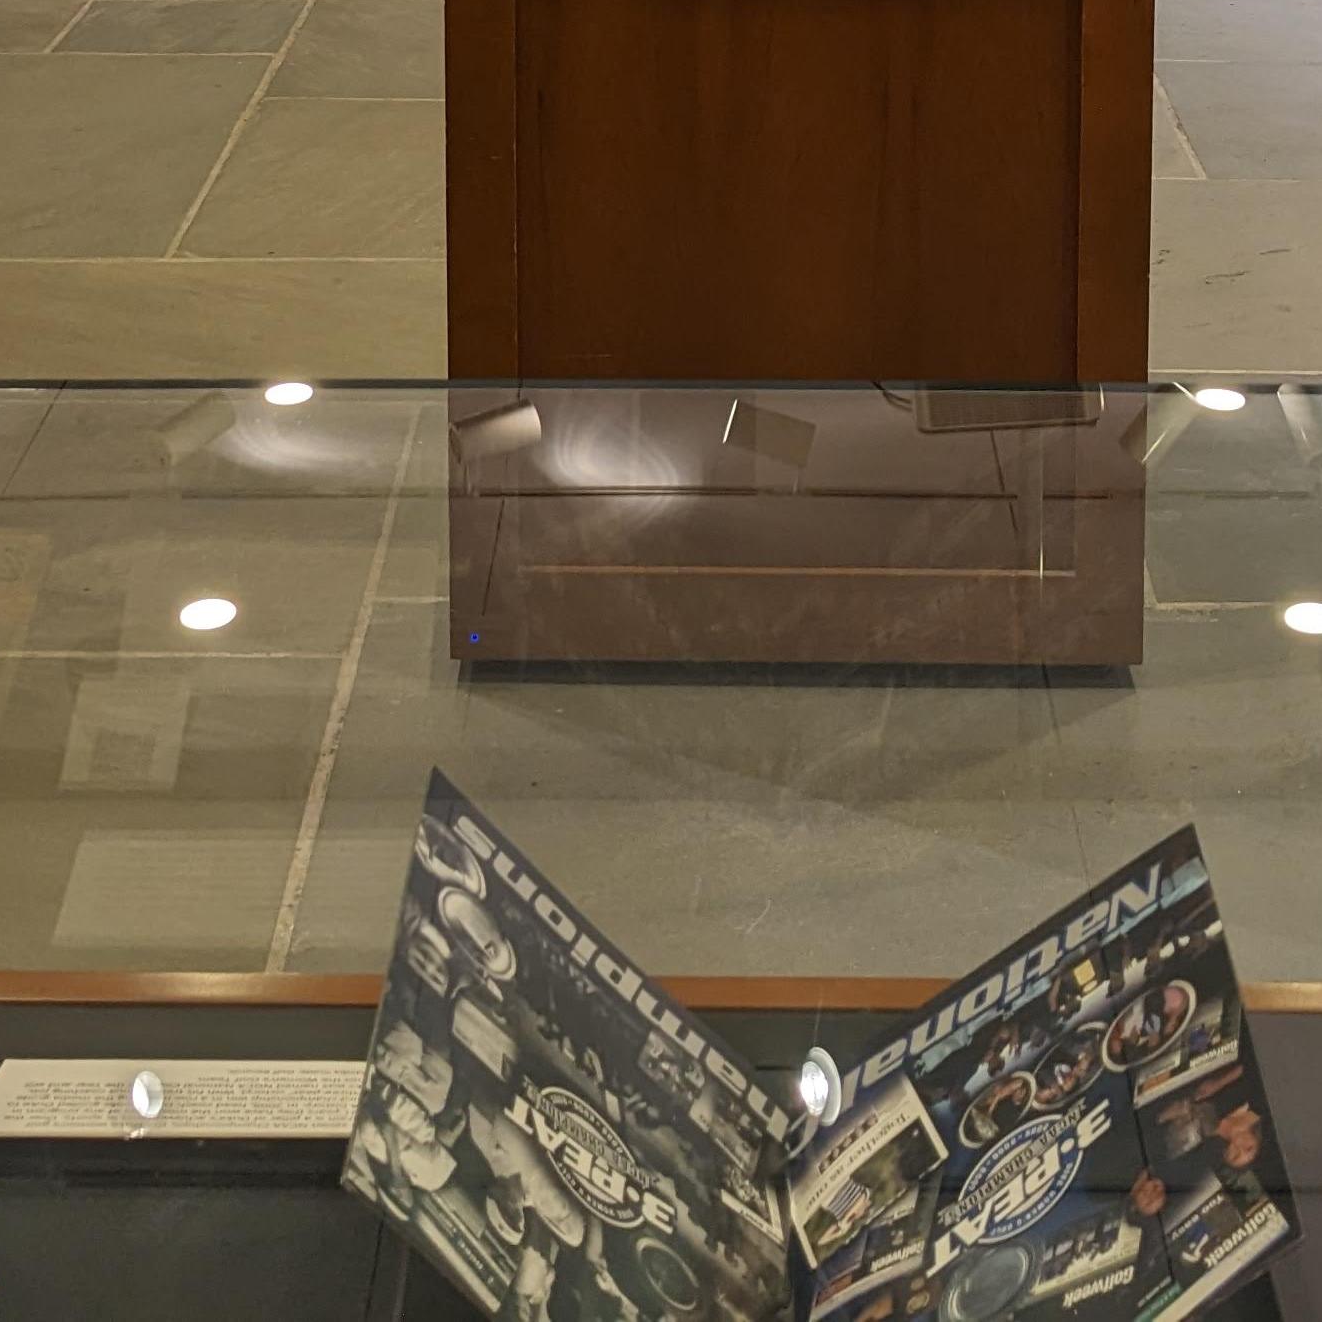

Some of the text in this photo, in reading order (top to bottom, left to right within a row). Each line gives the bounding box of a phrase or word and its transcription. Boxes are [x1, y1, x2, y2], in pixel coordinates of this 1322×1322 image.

[841, 862, 1161, 1113] National
[870, 1240, 924, 1271] Golfweek
[1204, 1202, 1277, 1268] Golfweek
[1062, 1265, 1134, 1308] Golfweek
